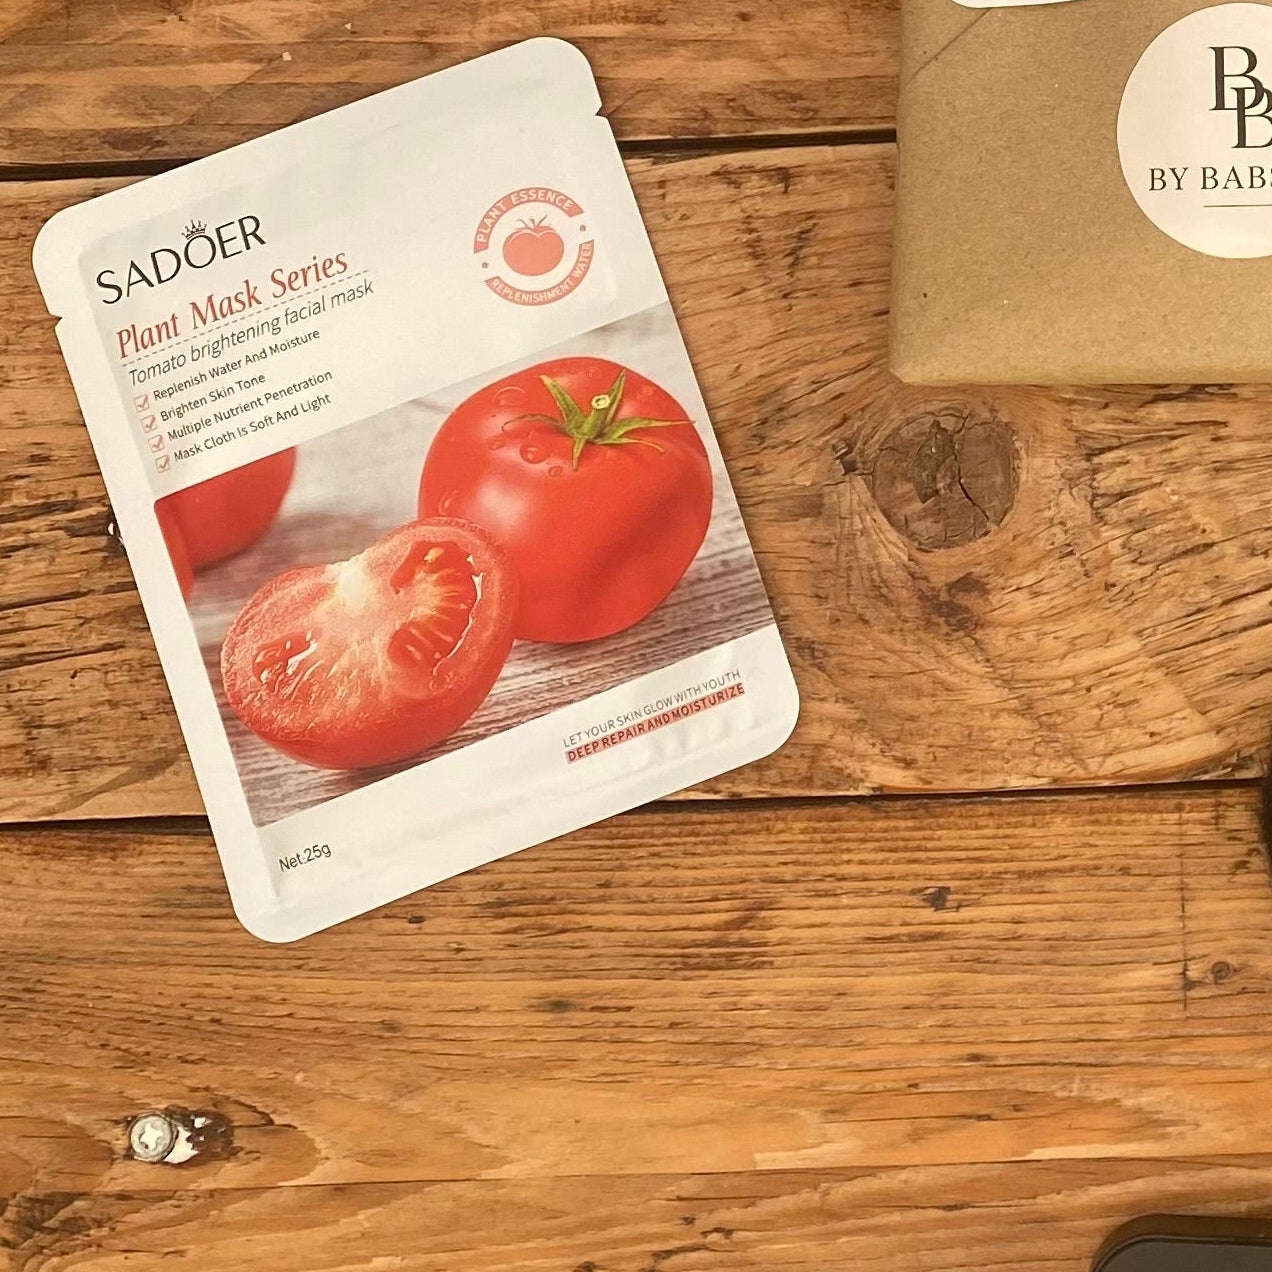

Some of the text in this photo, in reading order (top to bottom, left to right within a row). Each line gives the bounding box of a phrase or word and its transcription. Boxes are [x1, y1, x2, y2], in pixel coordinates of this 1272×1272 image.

[1148, 166, 1189, 191] BY
[476, 188, 574, 243] PLANT ESSENCE
[96, 214, 267, 305] SADOER
[490, 242, 592, 303] REPLENISHMENT WATER
[116, 252, 348, 360] Plant Mask Series
[128, 278, 375, 387] Tomato brightening facial mask
[153, 329, 321, 402] Replenish Water And Moisture
[160, 373, 267, 422] Brighten Skin Tone
[167, 370, 333, 442] Multiple Nutrient Penetration
[174, 443, 203, 462] Mask
[203, 429, 236, 450] Cloth
[250, 414, 275, 433] Soft
[276, 405, 299, 423] And
[300, 393, 332, 412] Light
[563, 669, 741, 748] LET YOUR SKIN GLOW WITH YOUTH
[567, 682, 746, 762] DEEP REPAIR AND MOISTURIZE
